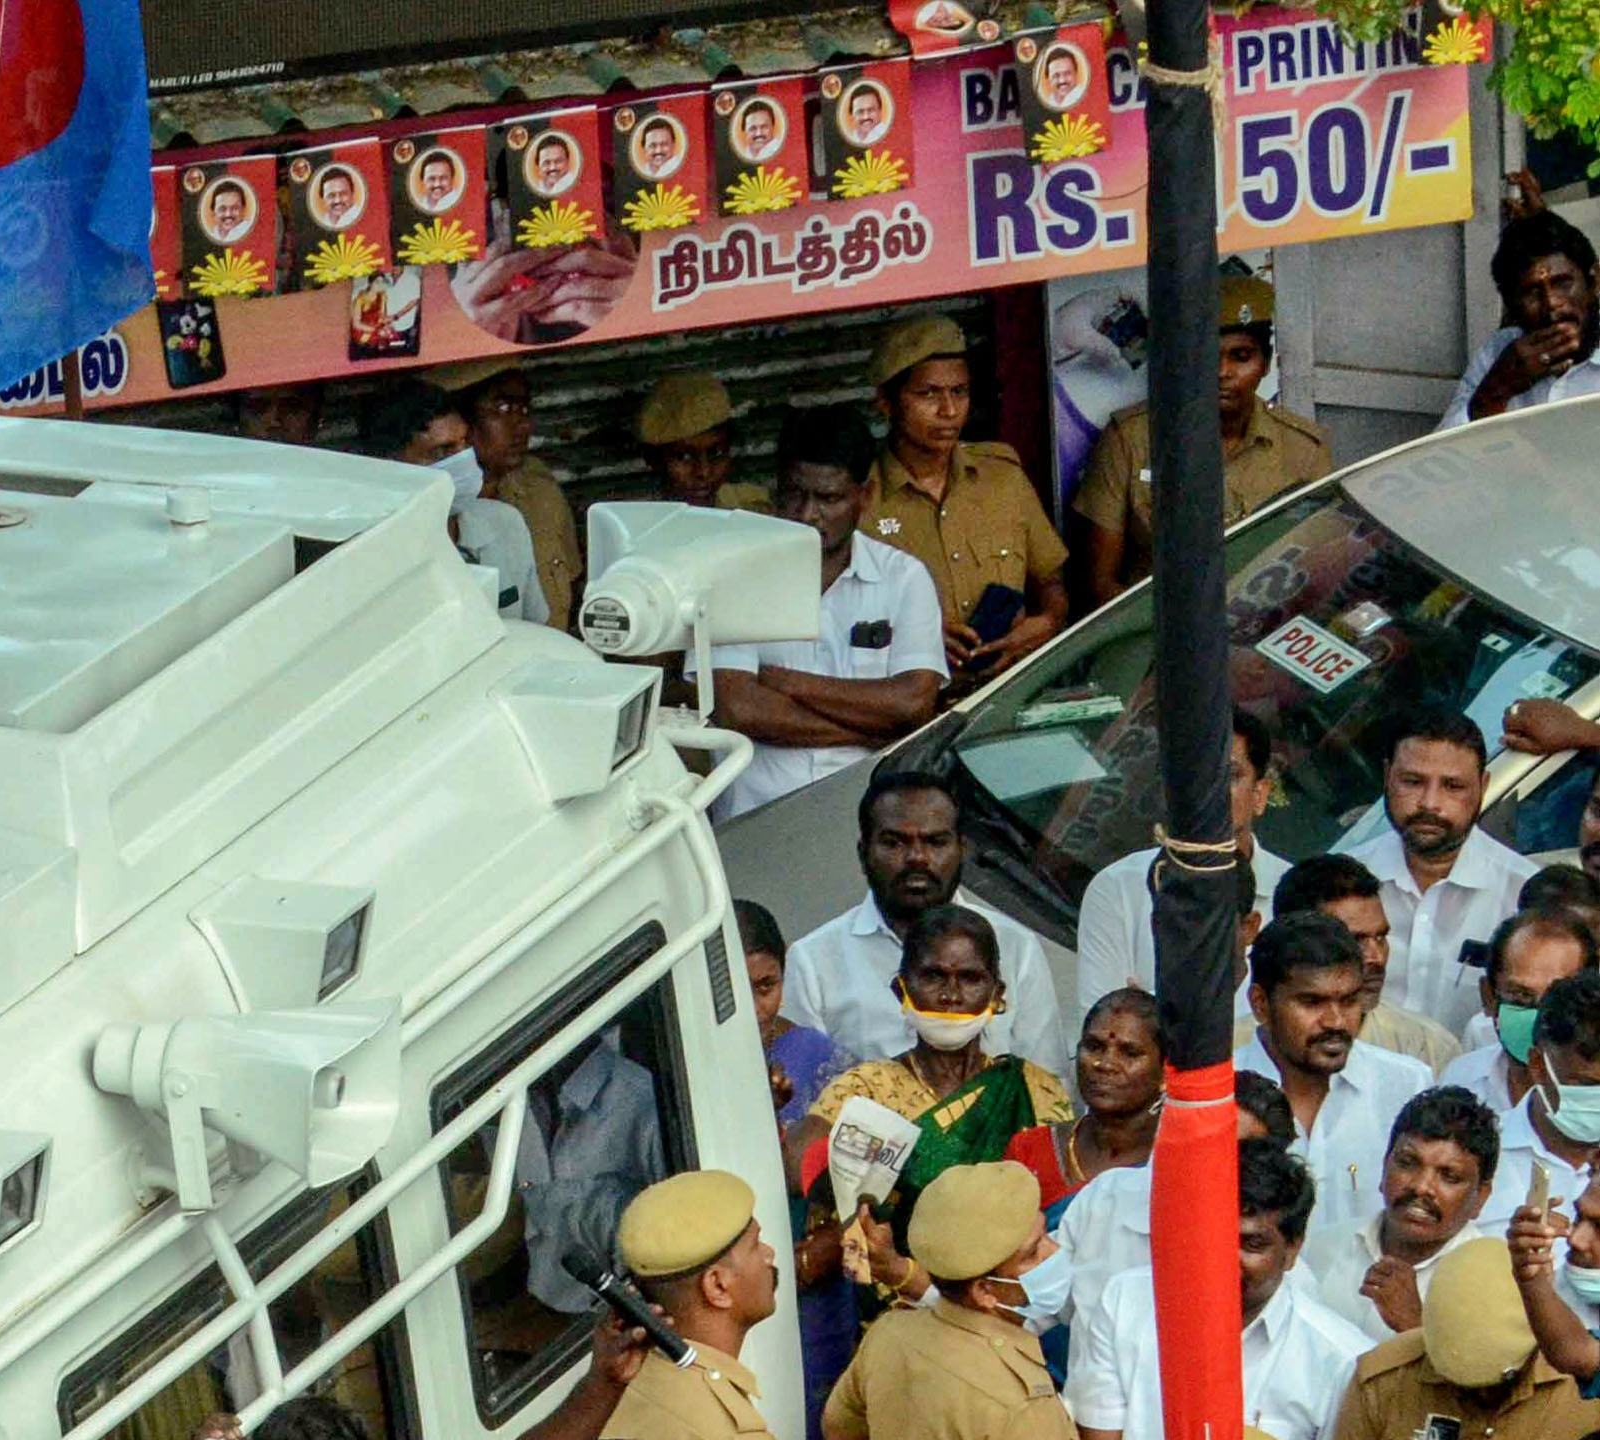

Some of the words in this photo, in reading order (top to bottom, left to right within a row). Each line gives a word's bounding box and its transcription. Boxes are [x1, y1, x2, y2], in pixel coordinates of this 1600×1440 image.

[1217, 96, 1450, 222] 50/-
[658, 207, 927, 304] நிமிடத்தில்
[1271, 626, 1354, 682] POLICE
